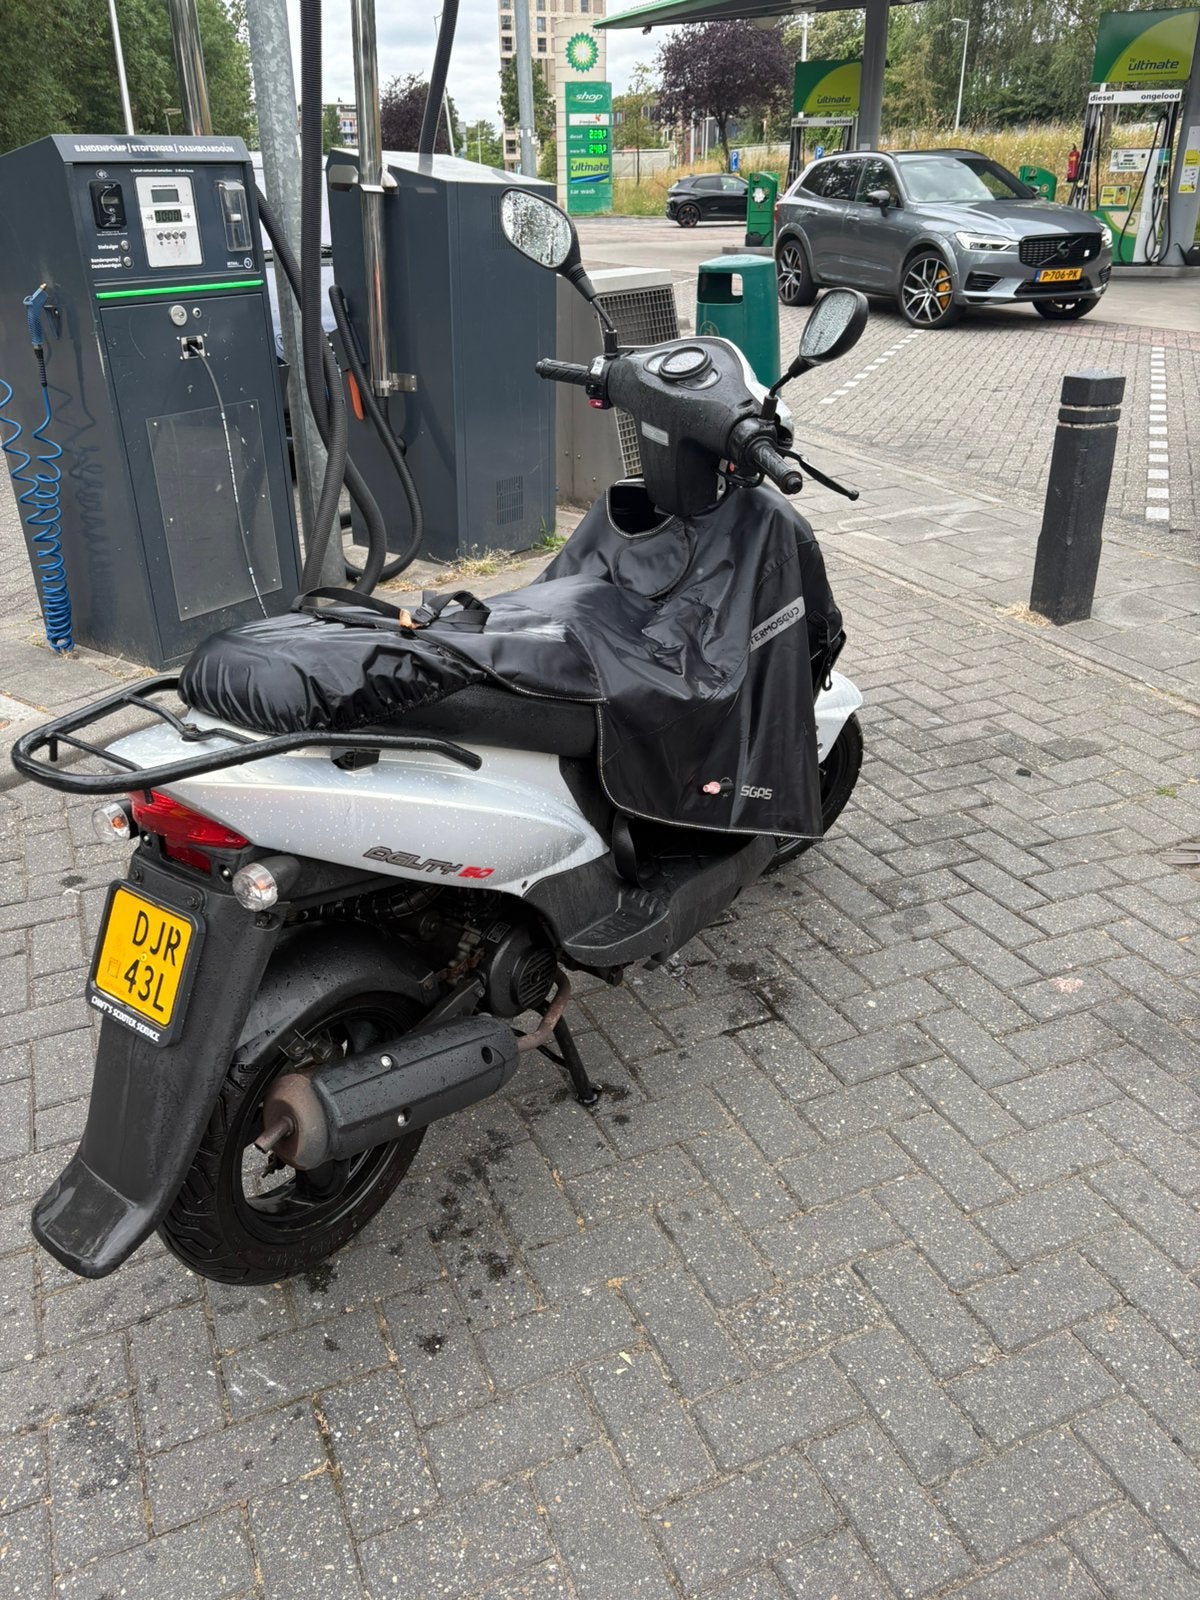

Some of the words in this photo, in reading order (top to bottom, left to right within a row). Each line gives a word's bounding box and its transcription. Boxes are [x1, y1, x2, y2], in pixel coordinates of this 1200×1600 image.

[1128, 59, 1179, 71] ultimate
[575, 91, 604, 103] shop
[816, 95, 852, 105] ultimate
[1141, 92, 1180, 100] ongelood
[571, 161, 609, 172] ultimate
[1042, 269, 1079, 280] P-706-PK
[740, 785, 773, 800] SGAS
[457, 865, 495, 879] 50
[132, 910, 181, 967] DJR
[124, 959, 164, 1012] 43L
[112, 1008, 136, 1028] SCOOTER
[136, 1022, 161, 1042] SERVICE
